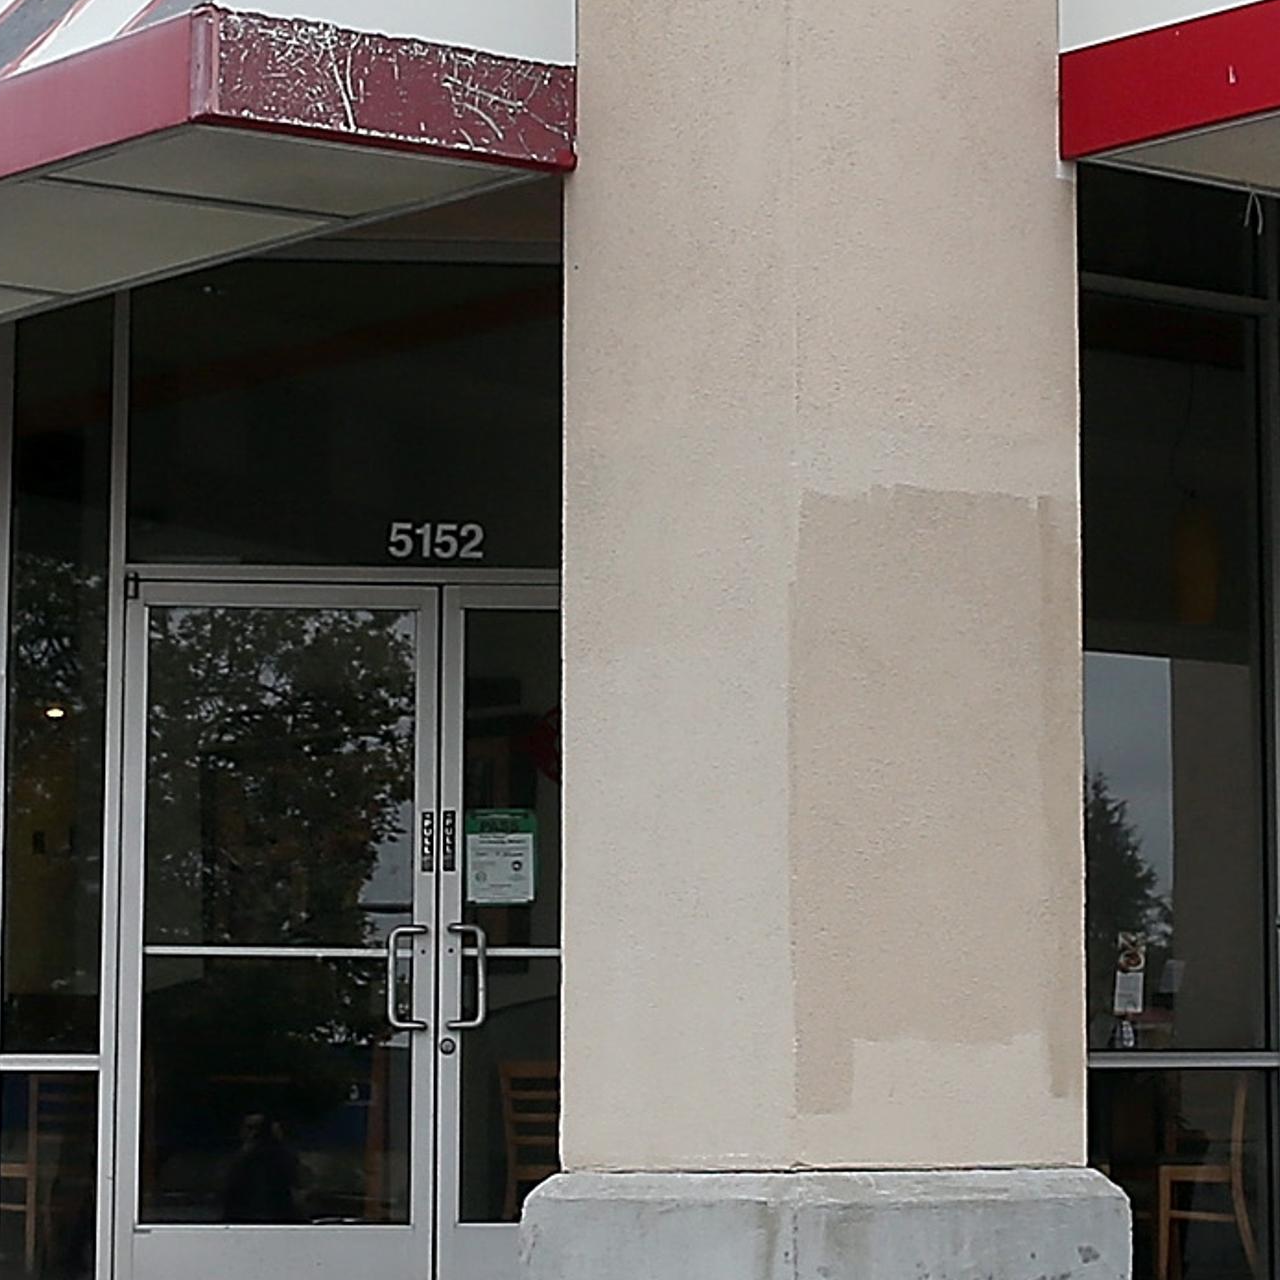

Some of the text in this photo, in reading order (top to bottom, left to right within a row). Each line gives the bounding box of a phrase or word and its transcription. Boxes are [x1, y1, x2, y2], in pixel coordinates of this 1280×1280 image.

[387, 522, 484, 558] 5152
[423, 819, 433, 854] PULL
[444, 818, 453, 854] PULL
